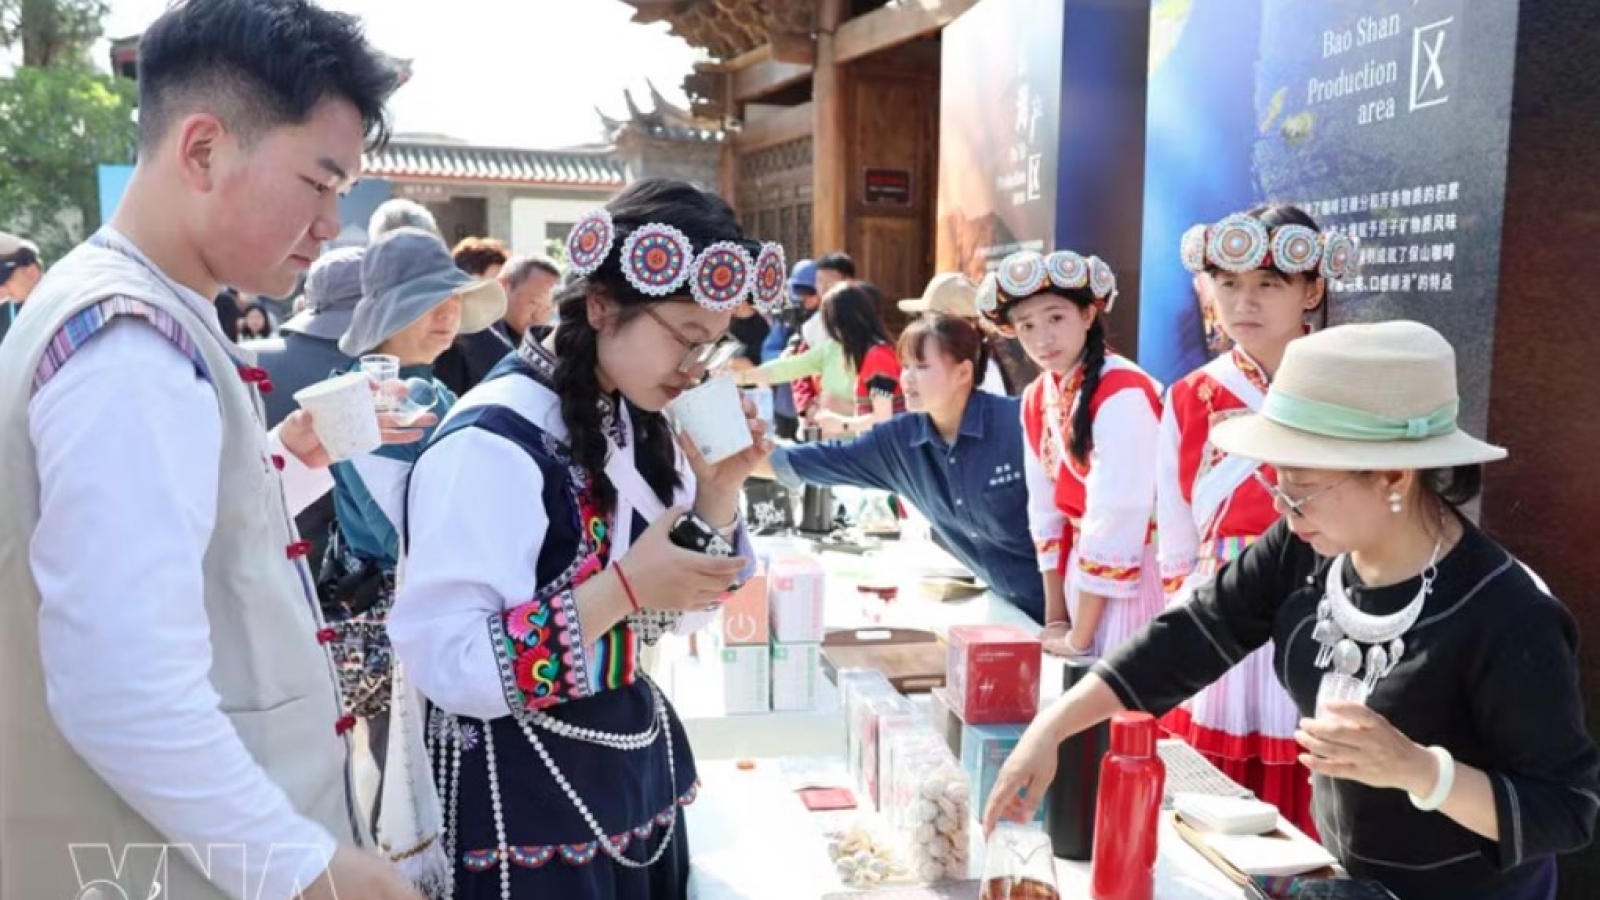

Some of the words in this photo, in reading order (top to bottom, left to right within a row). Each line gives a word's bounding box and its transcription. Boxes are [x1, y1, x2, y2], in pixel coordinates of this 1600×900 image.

[1323, 30, 1351, 58] Bao
[1356, 13, 1400, 47] Shan
[1409, 0, 1454, 112] 区
[1307, 59, 1397, 105] Production
[1357, 97, 1396, 125] area
